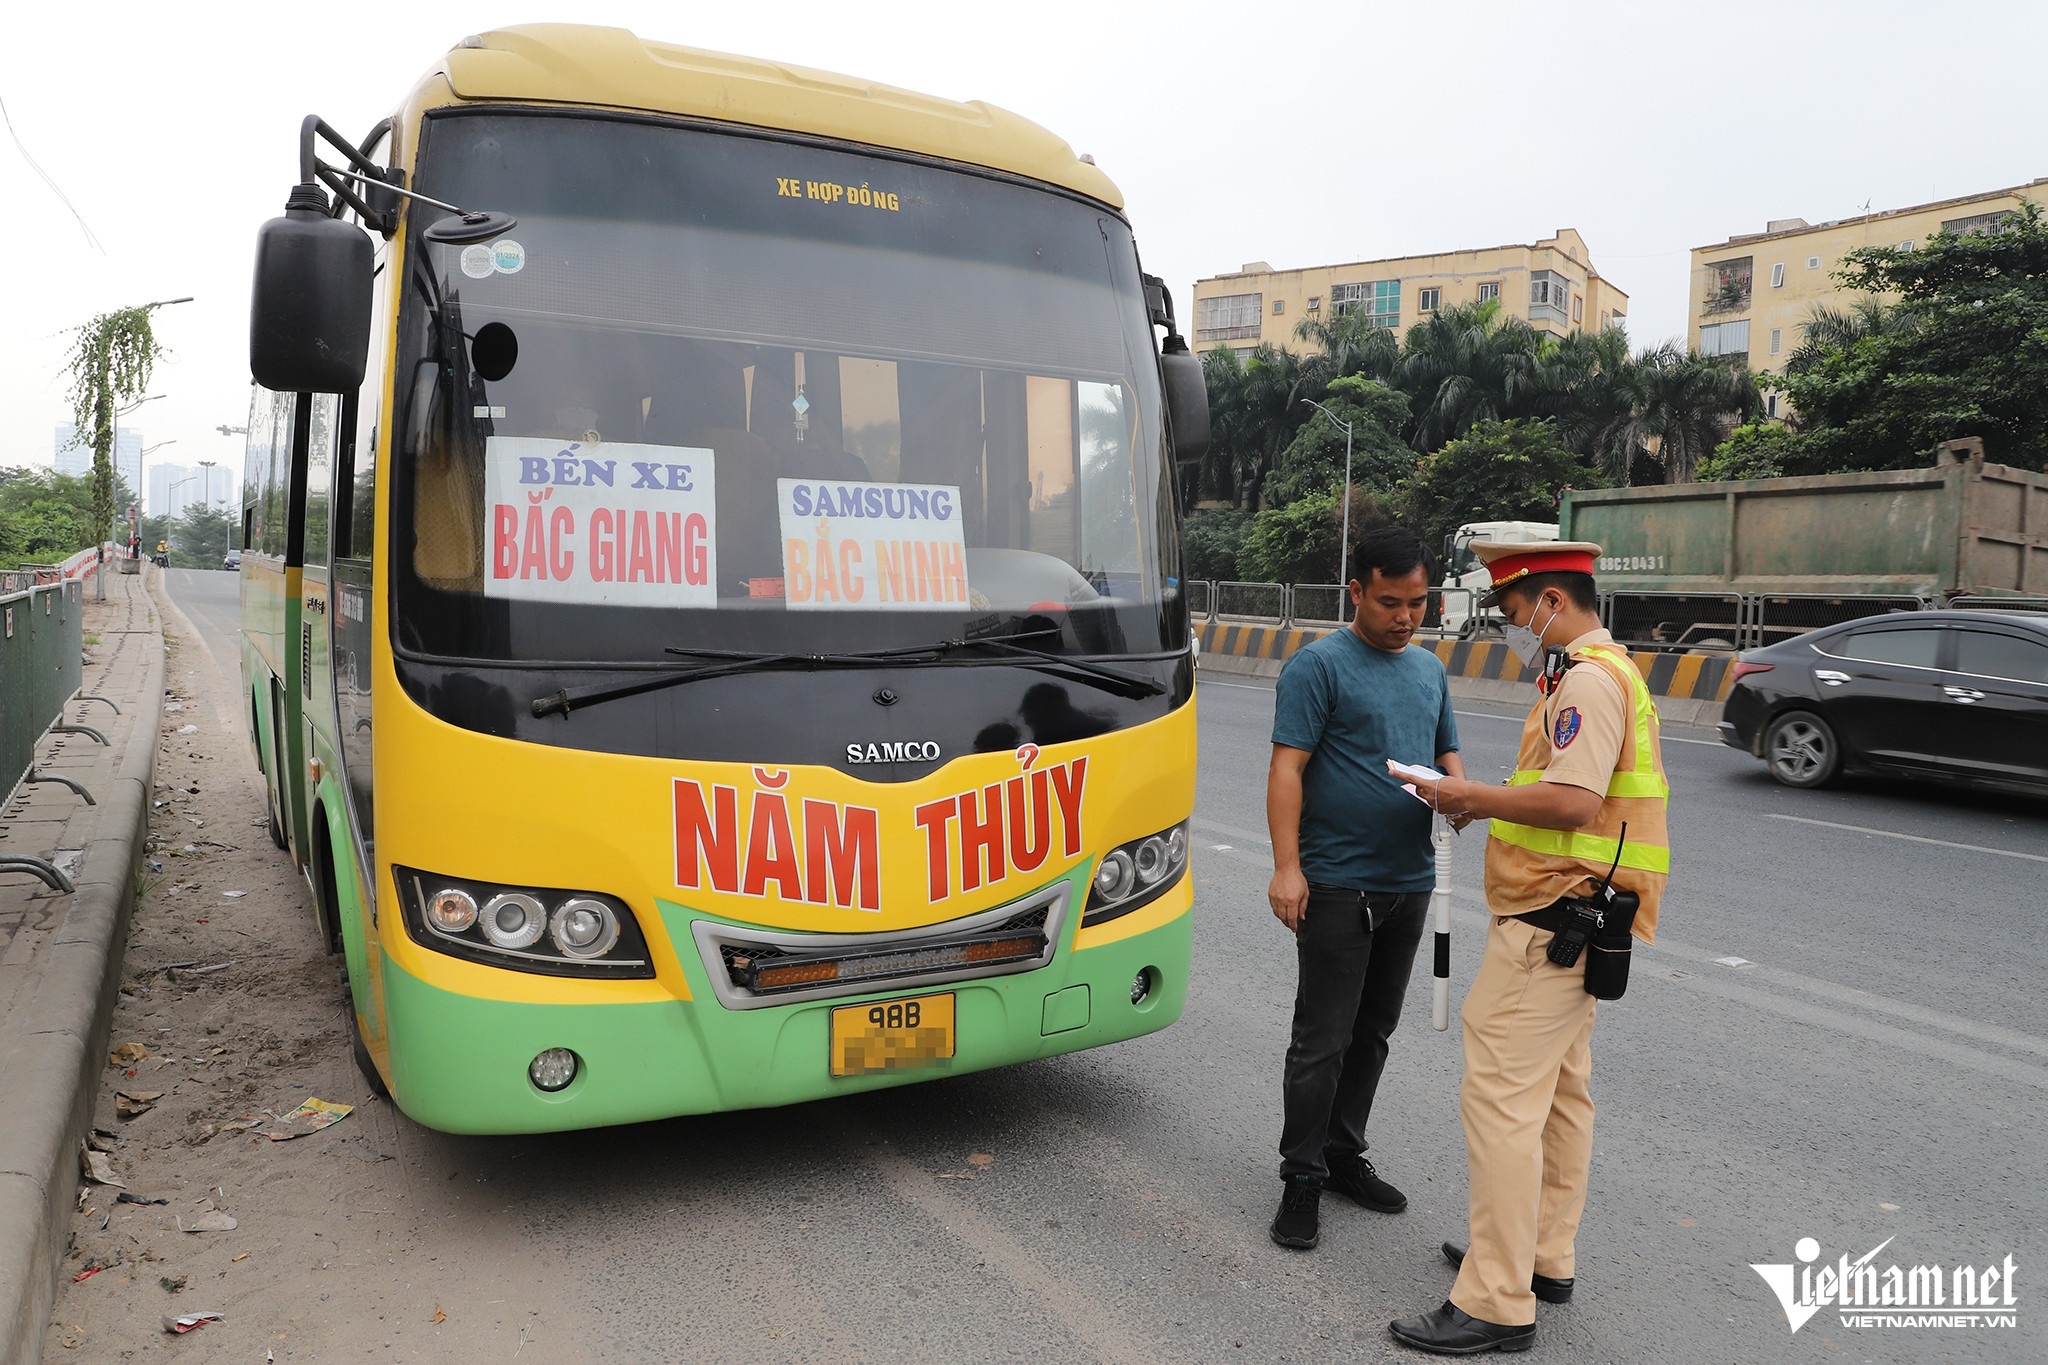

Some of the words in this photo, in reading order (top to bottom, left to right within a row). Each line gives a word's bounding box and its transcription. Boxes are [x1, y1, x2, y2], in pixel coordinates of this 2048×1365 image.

[776, 177, 802, 197] XE
[806, 181, 844, 204] HỢP
[846, 181, 899, 211] ĐỒNG
[519, 443, 617, 487] BẾN
[631, 462, 694, 492] XE
[792, 484, 953, 521] SAMSUNG
[493, 487, 575, 582] BẮC
[589, 507, 708, 586] GIANG
[786, 517, 865, 603] BẮC
[875, 539, 967, 602] NINH
[1599, 555, 1664, 571] 88C20431
[846, 741, 941, 763] SAMCO
[671, 765, 881, 913] NĂM
[914, 743, 1090, 905] THỦY
[868, 1001, 920, 1029] 98B
